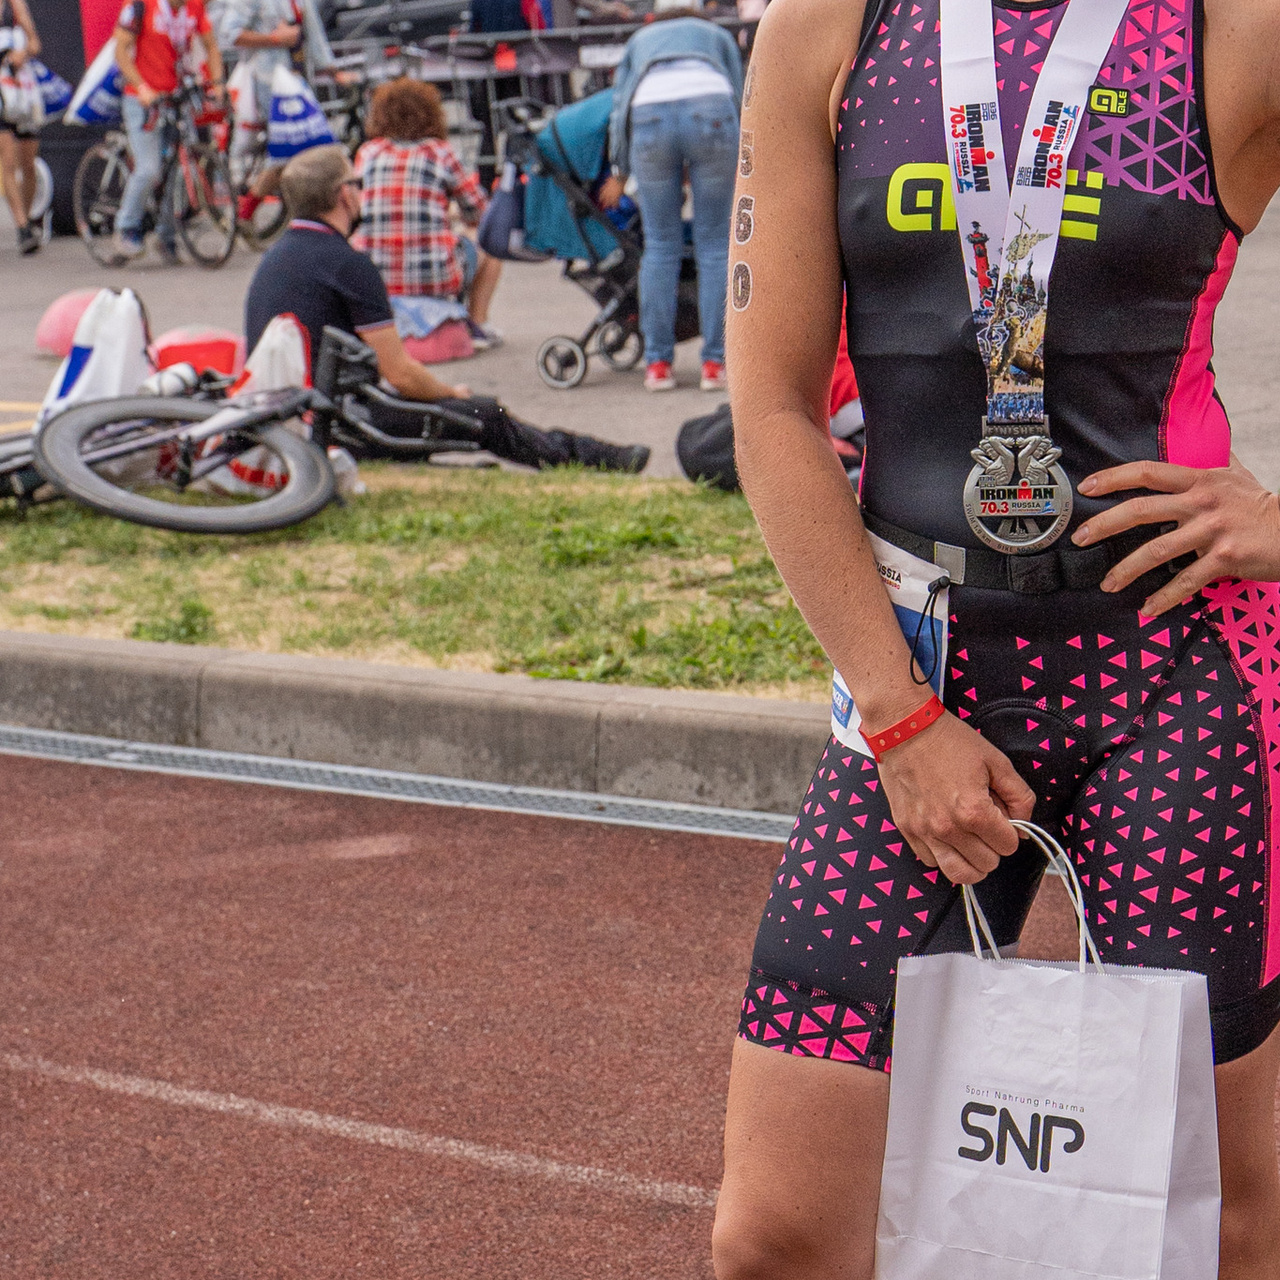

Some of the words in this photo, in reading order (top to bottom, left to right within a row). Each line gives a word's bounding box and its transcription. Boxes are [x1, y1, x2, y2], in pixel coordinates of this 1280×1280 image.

[949, 105, 967, 139] 70.3
[959, 141, 971, 177] RUSSIA
[965, 103, 994, 193] IRONMAN
[1031, 100, 1064, 188] IRONMAN
[1053, 118, 1069, 151] RUSSIA
[1045, 153, 1064, 189] 70.3
[988, 425, 1044, 435] FINISHER
[980, 480, 1055, 500] IRONMAN
[980, 502, 1009, 514] 70.3
[965, 1085, 989, 1098] Sport
[994, 1091, 1039, 1107] Nahrung
[1045, 1099, 1085, 1113] Pharma
[958, 1101, 1085, 1173] SNP
